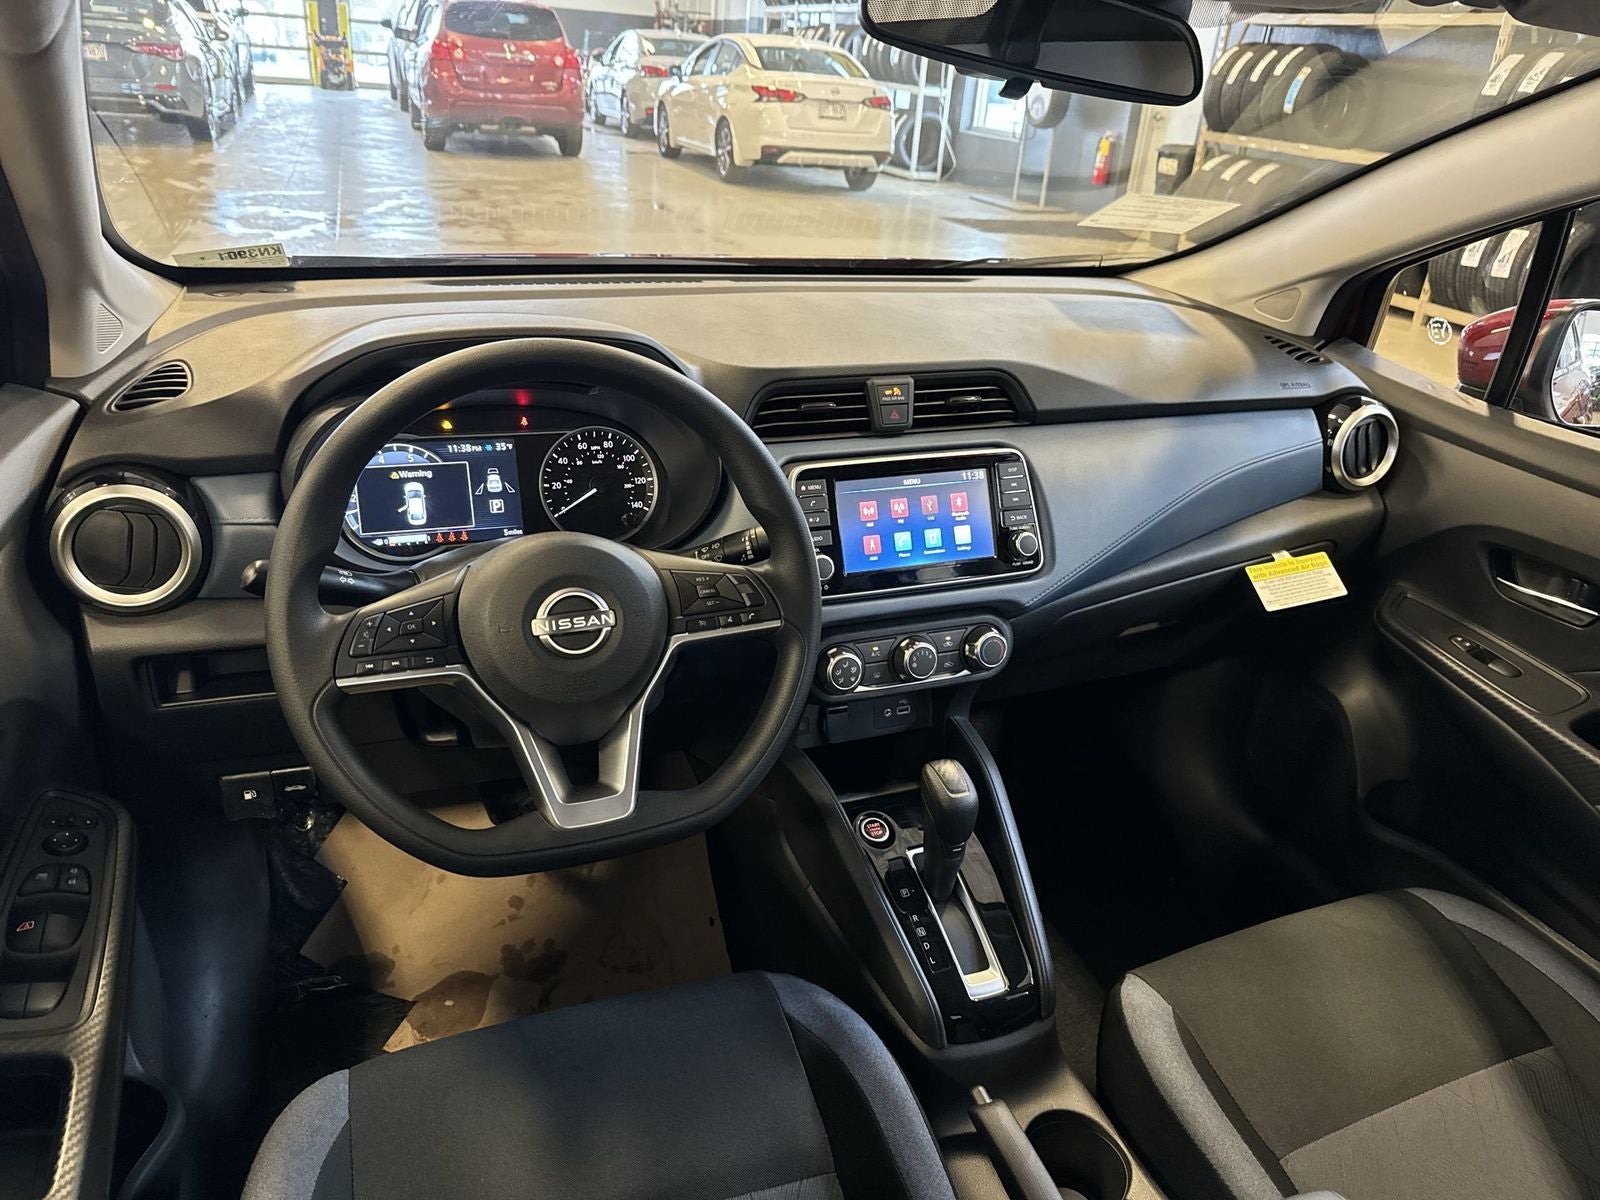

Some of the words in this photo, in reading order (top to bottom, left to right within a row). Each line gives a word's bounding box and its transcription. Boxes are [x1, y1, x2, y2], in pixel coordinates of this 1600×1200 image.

[577, 442, 588, 450] 60
[603, 440, 614, 448] 80
[407, 453, 415, 462] 5
[557, 457, 568, 465] 40
[623, 454, 635, 462] 100
[399, 469, 434, 480] Warning
[961, 470, 985, 481] 11:38
[634, 476, 647, 485] 120
[903, 477, 921, 485] MENU
[551, 481, 562, 490] 20
[492, 500, 501, 511] P
[631, 501, 643, 509] 140
[536, 613, 613, 632] NISSAN
[912, 914, 920, 922] R
[923, 942, 931, 950] D
[929, 956, 936, 965] L
